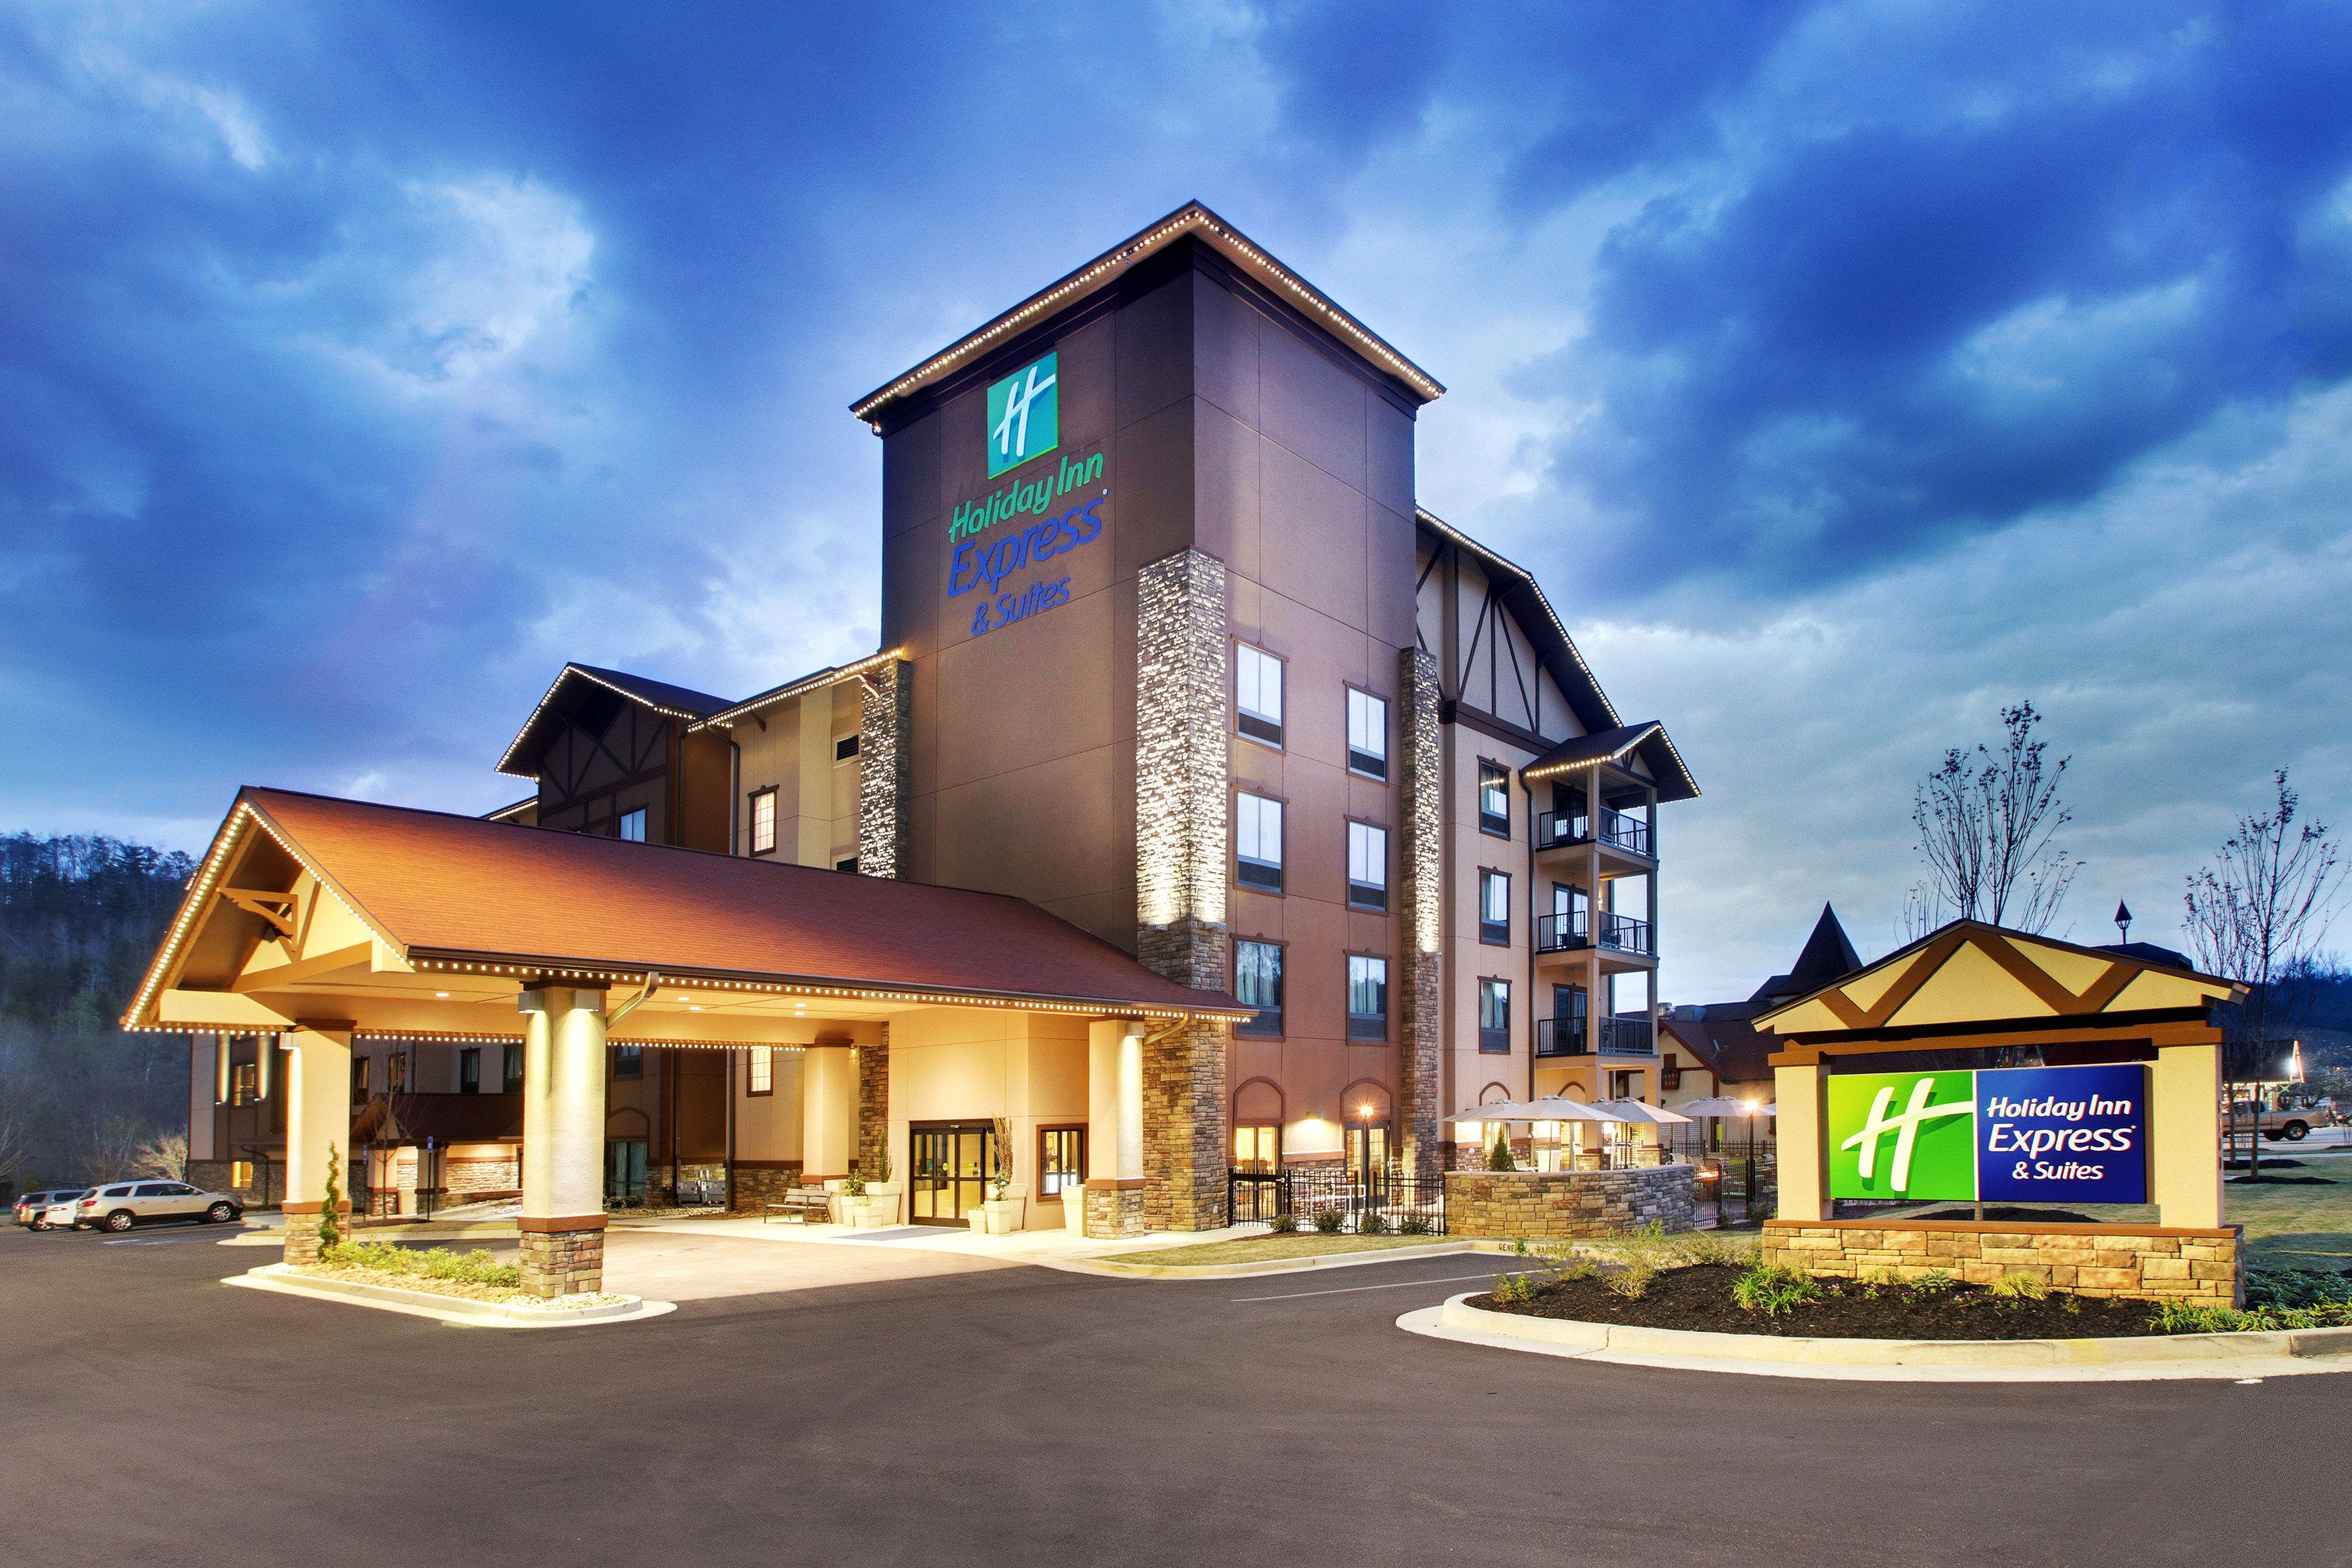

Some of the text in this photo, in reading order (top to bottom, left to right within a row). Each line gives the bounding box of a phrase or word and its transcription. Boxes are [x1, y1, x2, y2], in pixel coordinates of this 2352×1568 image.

[948, 452, 1103, 543] Holiday Inn
[948, 497, 1103, 597] Express
[971, 576, 1071, 636] & Suites
[1986, 1094, 2132, 1121] Holiday Inn
[1988, 1123, 2133, 1159] Express
[2012, 1161, 2105, 1180] & Suites
